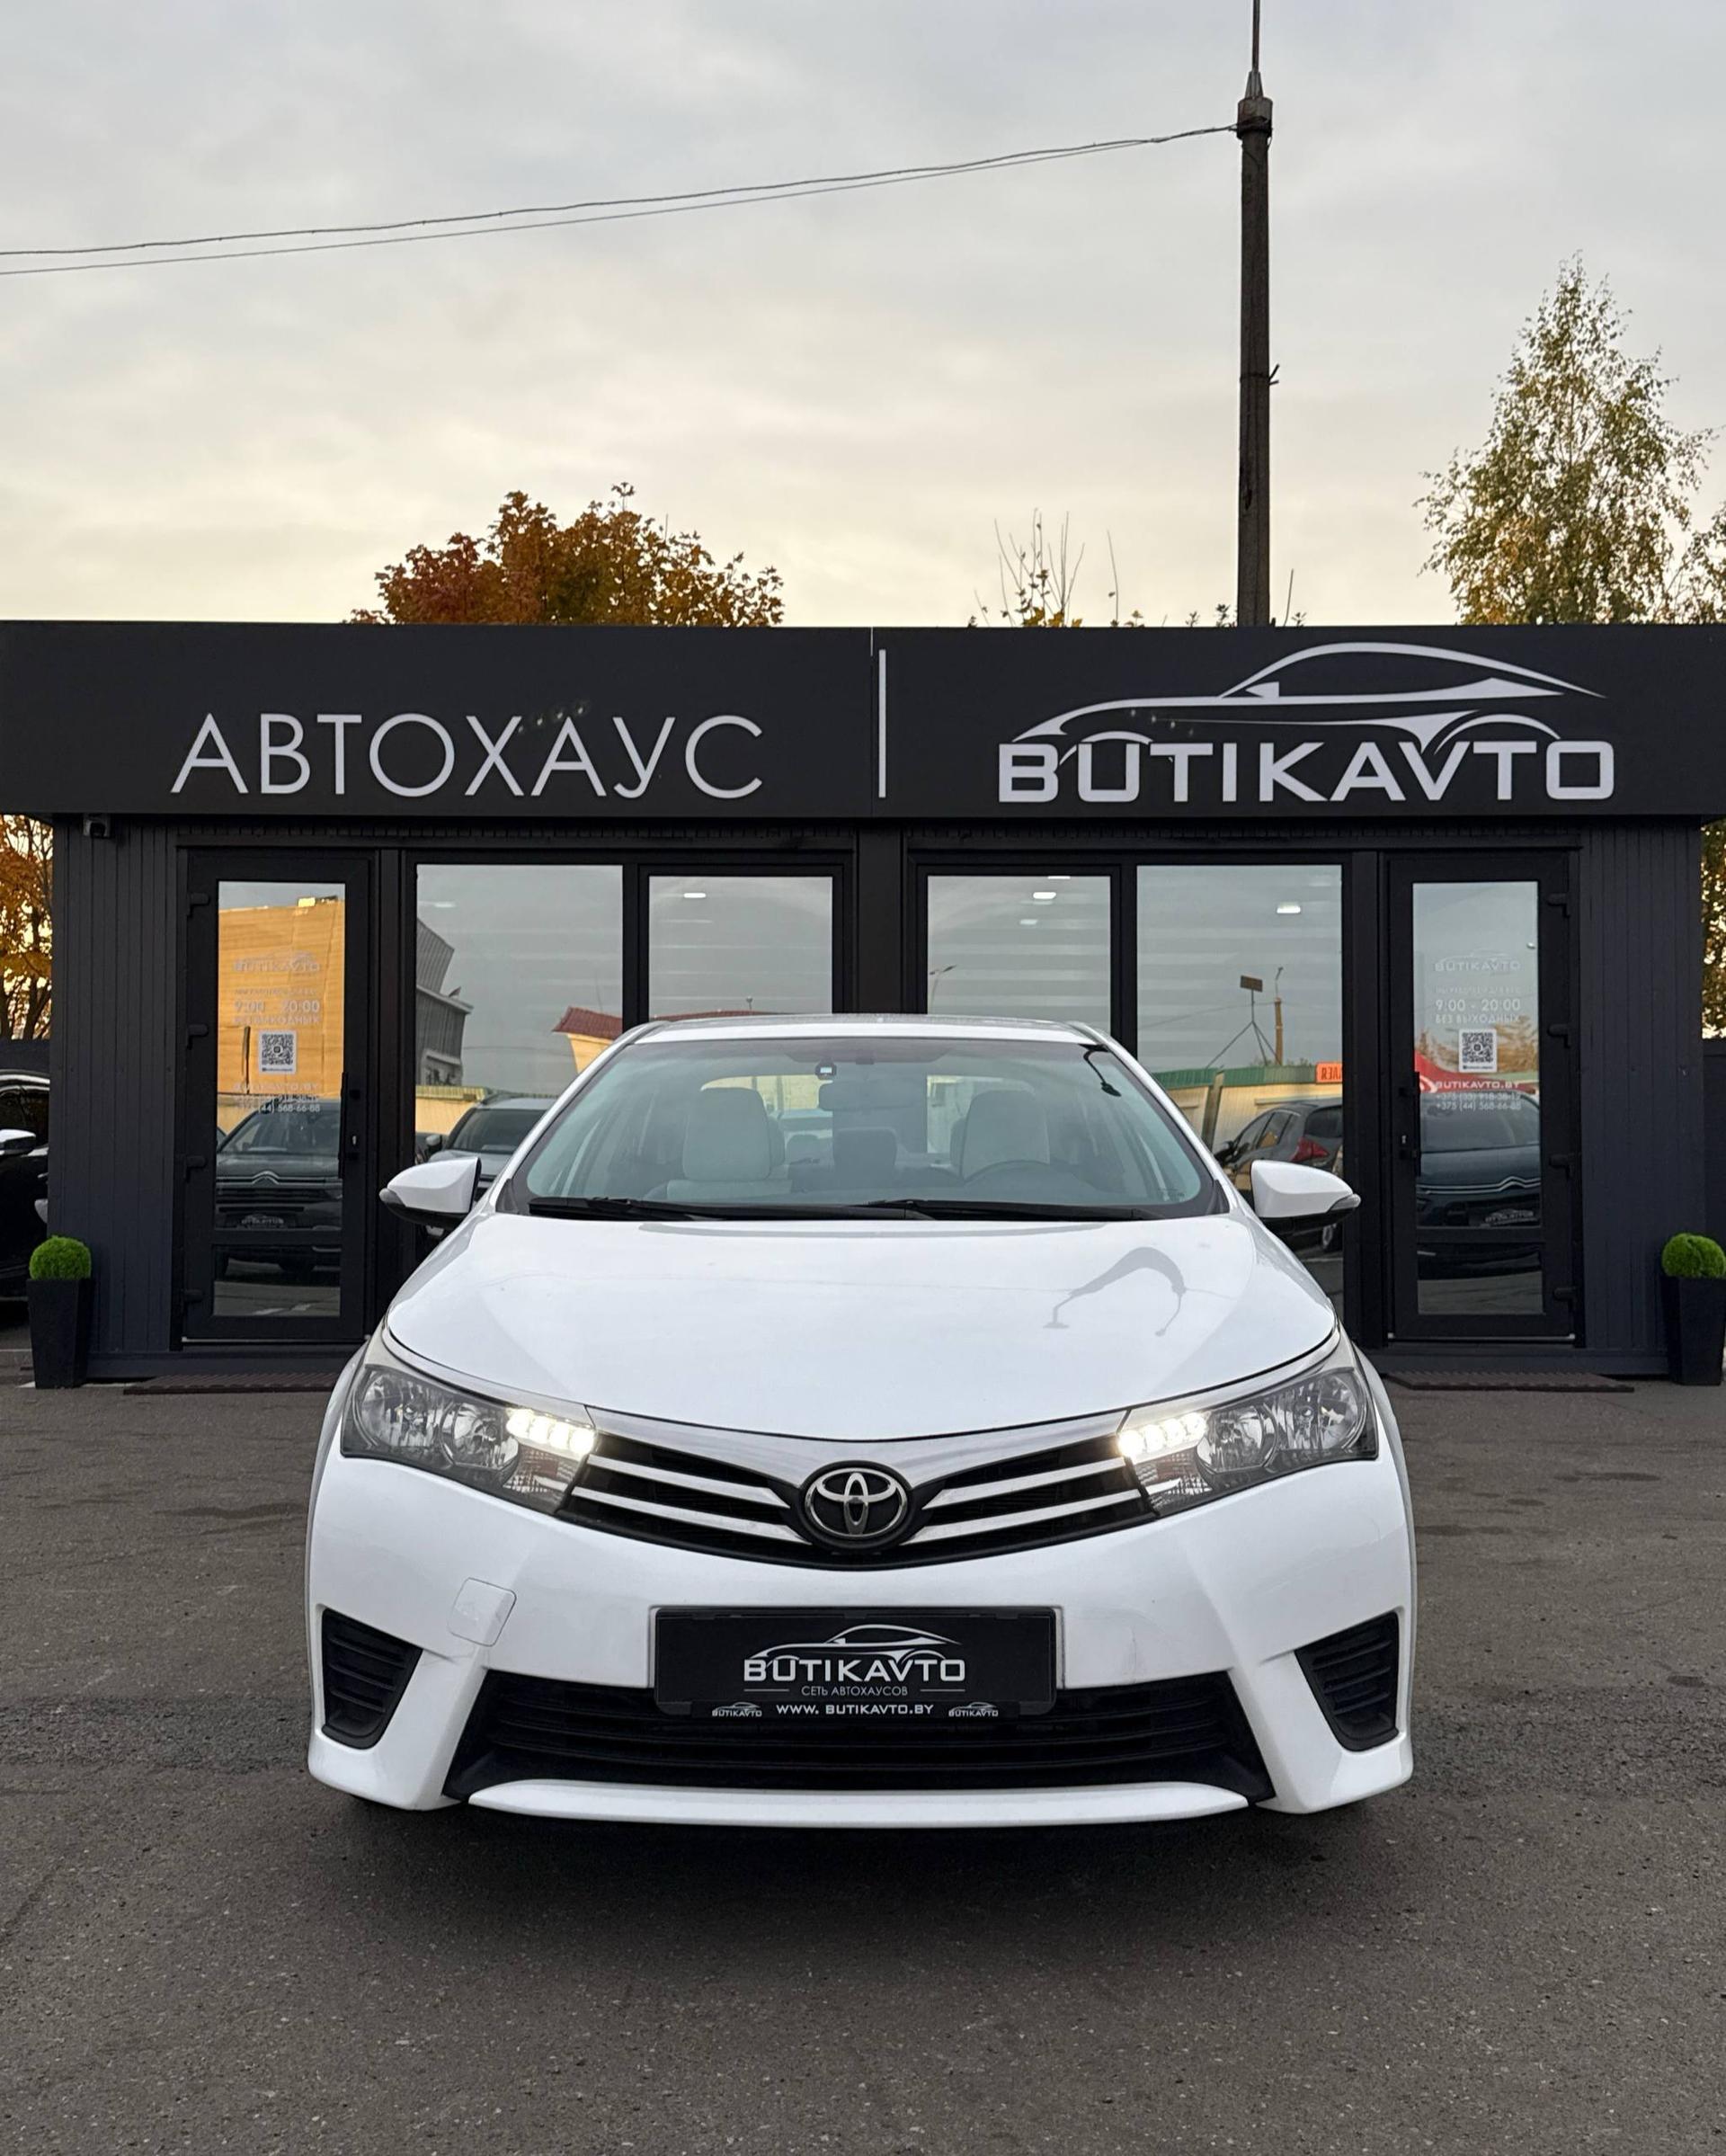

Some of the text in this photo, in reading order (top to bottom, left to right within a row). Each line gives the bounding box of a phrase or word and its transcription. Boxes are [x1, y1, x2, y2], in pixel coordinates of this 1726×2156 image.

[171, 712, 763, 799] АВТОХАУС
[998, 740, 1615, 803] BUTIKAVTO
[1435, 960, 1521, 972] BUTIKAVTO
[1436, 1081, 1519, 1089] BUTIKAVTO.BY
[743, 1660, 965, 1682] BUTIKAVTO
[801, 1686, 908, 1697] СЕТЬ АВТОХАУСОВ
[712, 1709, 762, 1717] BUTIKAVTO
[776, 1704, 934, 1715] WWW. BUTIKAVTO.BY
